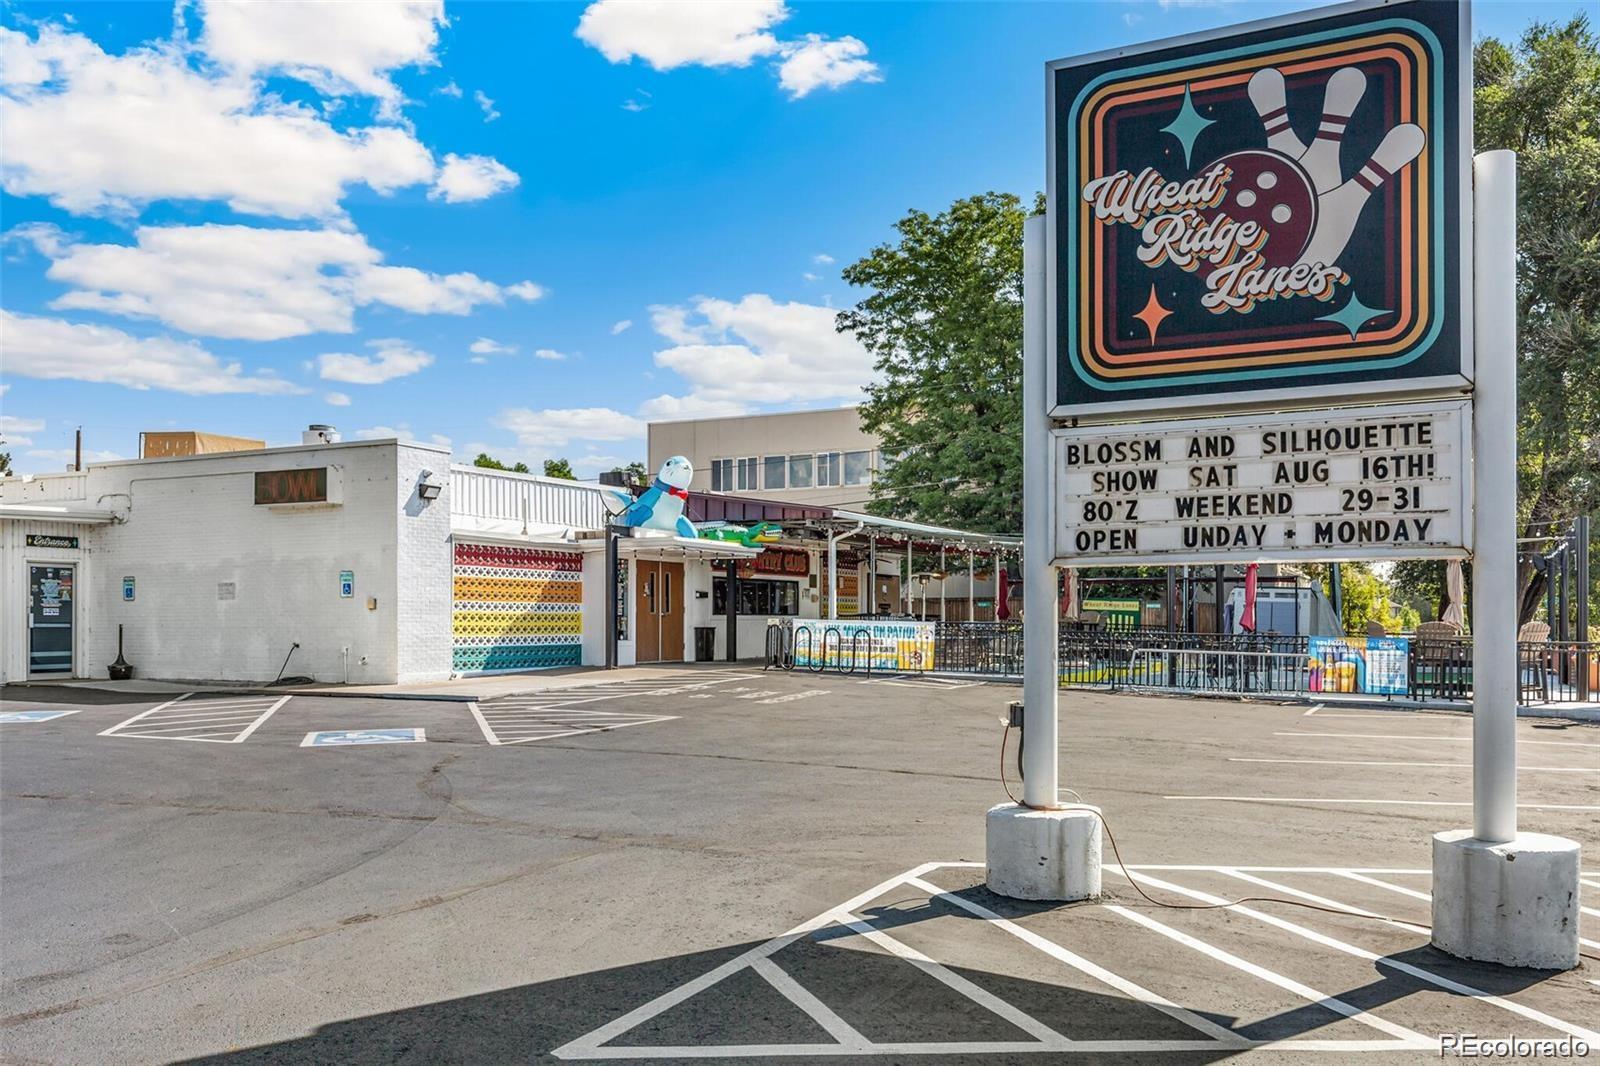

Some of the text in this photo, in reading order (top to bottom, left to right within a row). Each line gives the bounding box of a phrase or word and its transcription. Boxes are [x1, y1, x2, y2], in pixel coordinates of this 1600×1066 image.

[1083, 163, 1231, 228] Wheat
[1137, 209, 1266, 270] Ridge
[1201, 251, 1347, 313] Lanes
[1066, 421, 1433, 465] BLOSSM AND SILHOUETTE
[1092, 453, 1435, 493] SHOW SAT AUG 16TH!
[1083, 486, 1421, 522] 80'Z WEEKEND 29-31
[1075, 528, 1138, 552] OPEN
[1183, 524, 1267, 548] UNDAY
[1314, 518, 1432, 545] MONDAY
[873, 625, 887, 638] ON
